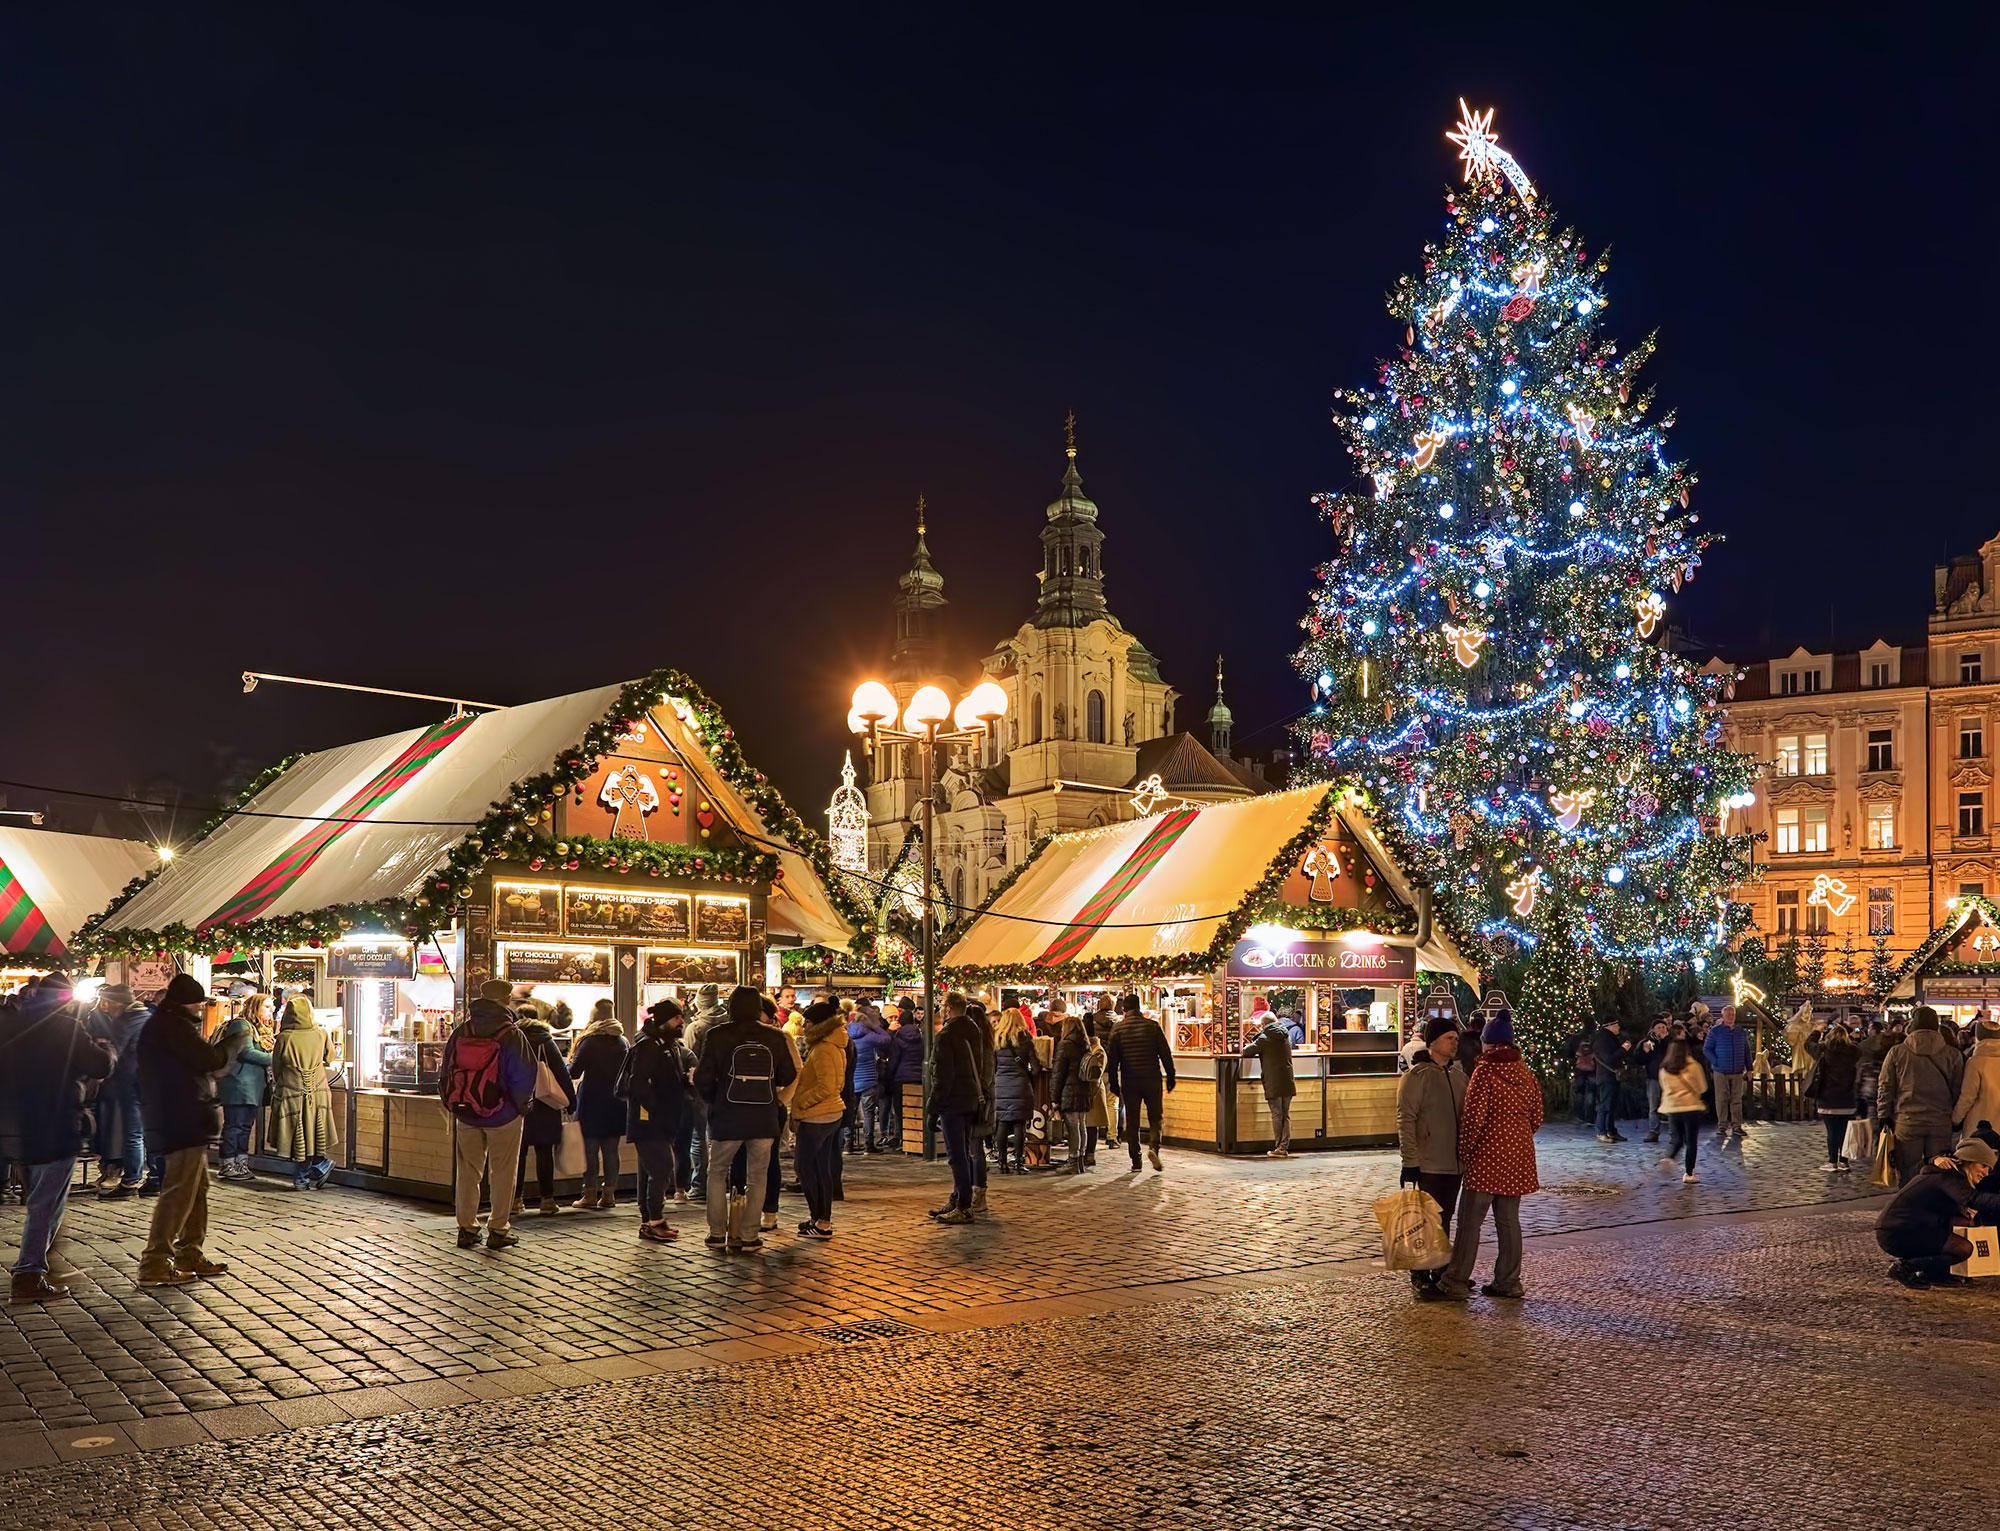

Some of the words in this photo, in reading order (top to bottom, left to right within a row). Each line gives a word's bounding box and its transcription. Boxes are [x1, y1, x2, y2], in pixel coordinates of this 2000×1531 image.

[578, 892, 594, 901] HOT
[595, 893, 619, 903] PUNCH
[619, 895, 626, 903] &
[357, 953, 366, 961] HOT
[367, 953, 393, 961] CHOCOLATE
[524, 951, 564, 960] CHOCOLATE
[1273, 949, 1324, 969] CHICKEN
[1327, 955, 1337, 968] &
[1340, 950, 1387, 969] DRINKS
